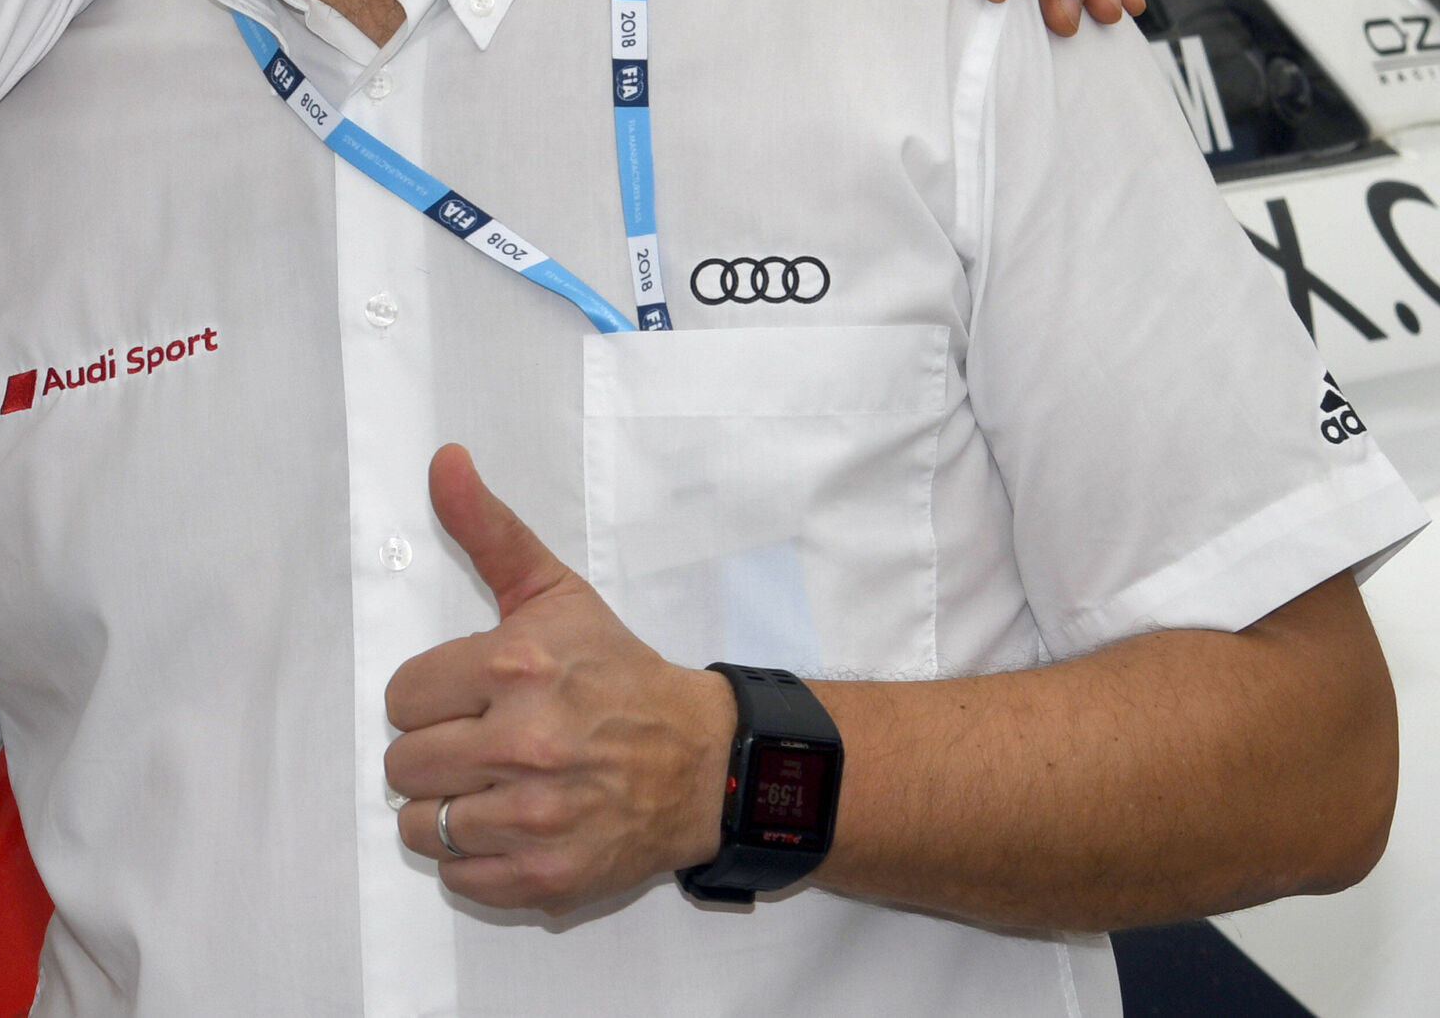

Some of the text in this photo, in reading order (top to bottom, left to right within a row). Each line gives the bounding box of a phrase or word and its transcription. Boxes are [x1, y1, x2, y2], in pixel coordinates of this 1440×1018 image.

[300, 93, 329, 126] 2018
[620, 11, 637, 49] 2018
[636, 248, 653, 293] 2018
[486, 232, 528, 261] 2018
[42, 327, 219, 397] Audi Sport
